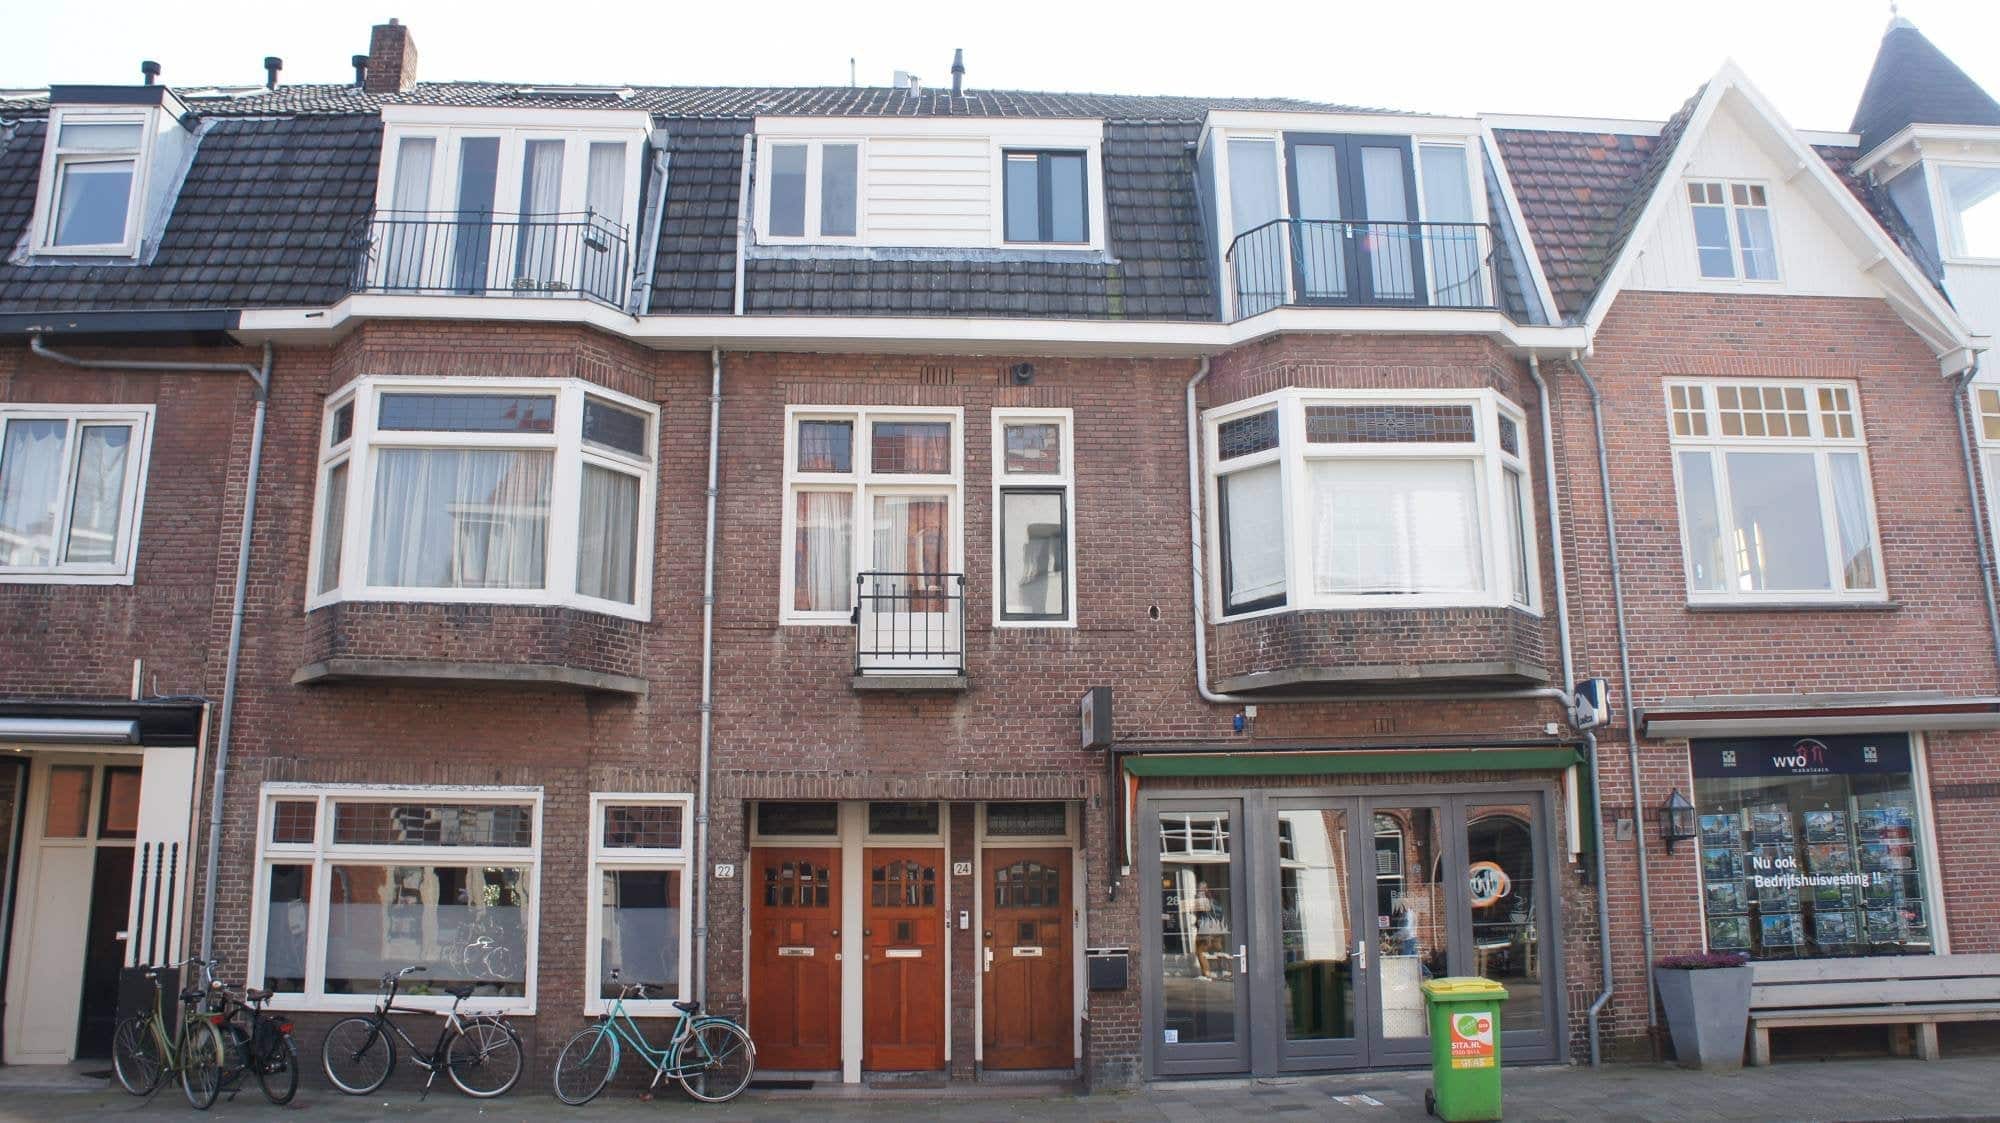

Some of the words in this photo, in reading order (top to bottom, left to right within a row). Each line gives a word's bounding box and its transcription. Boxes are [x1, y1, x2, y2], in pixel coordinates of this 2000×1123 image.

[1753, 856, 1771, 869] Nu
[1775, 853, 1797, 868] ook
[718, 865, 731, 876] 22
[956, 863, 968, 873] 24
[1755, 872, 1869, 889] Bedrijfshuisvesting
